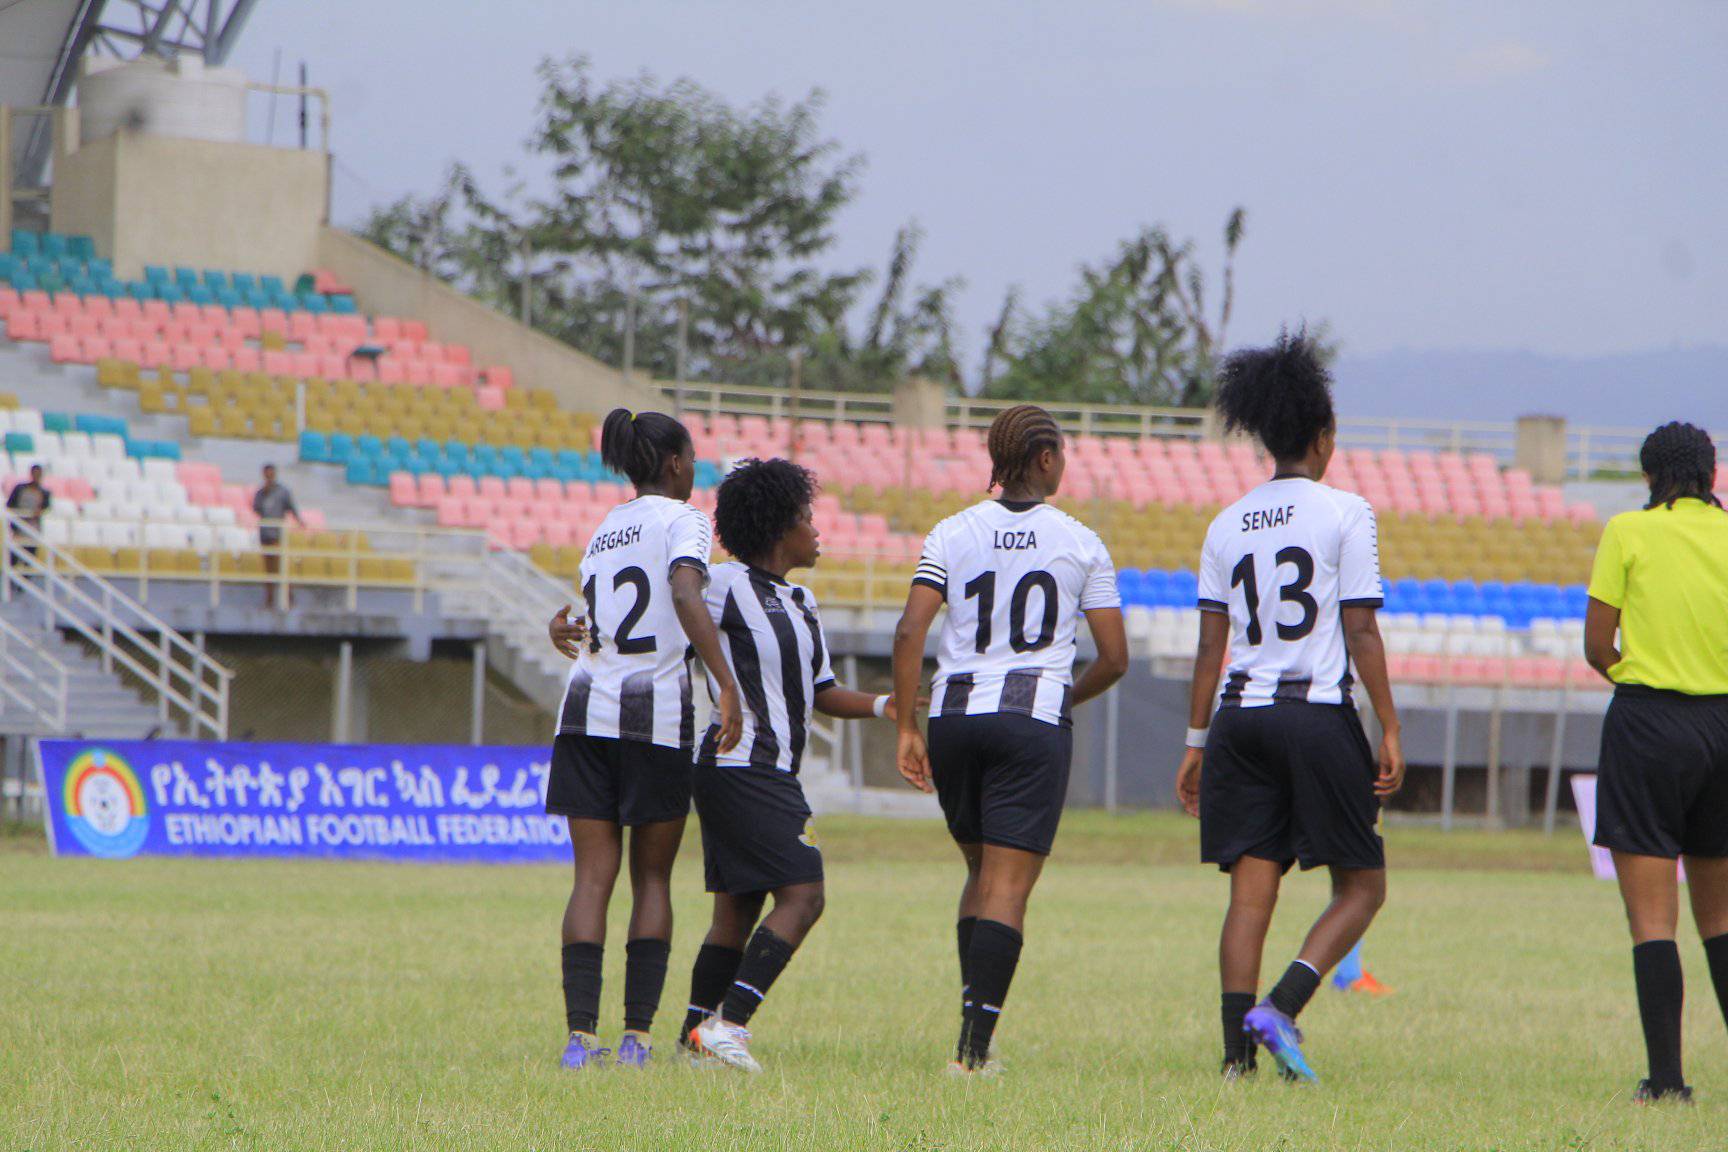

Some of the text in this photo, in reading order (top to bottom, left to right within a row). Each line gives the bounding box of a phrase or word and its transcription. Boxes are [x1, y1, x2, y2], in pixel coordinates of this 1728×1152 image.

[1241, 505, 1295, 532] SENAF
[587, 523, 642, 559] AREGASH
[994, 530, 1037, 550] LOZA
[583, 565, 657, 655] 12
[965, 569, 1059, 655] 10
[1230, 546, 1319, 646] 13
[314, 762, 390, 808] እግር
[165, 812, 570, 846] ETHIOPIAN FOOTBALL FEDERATIO
